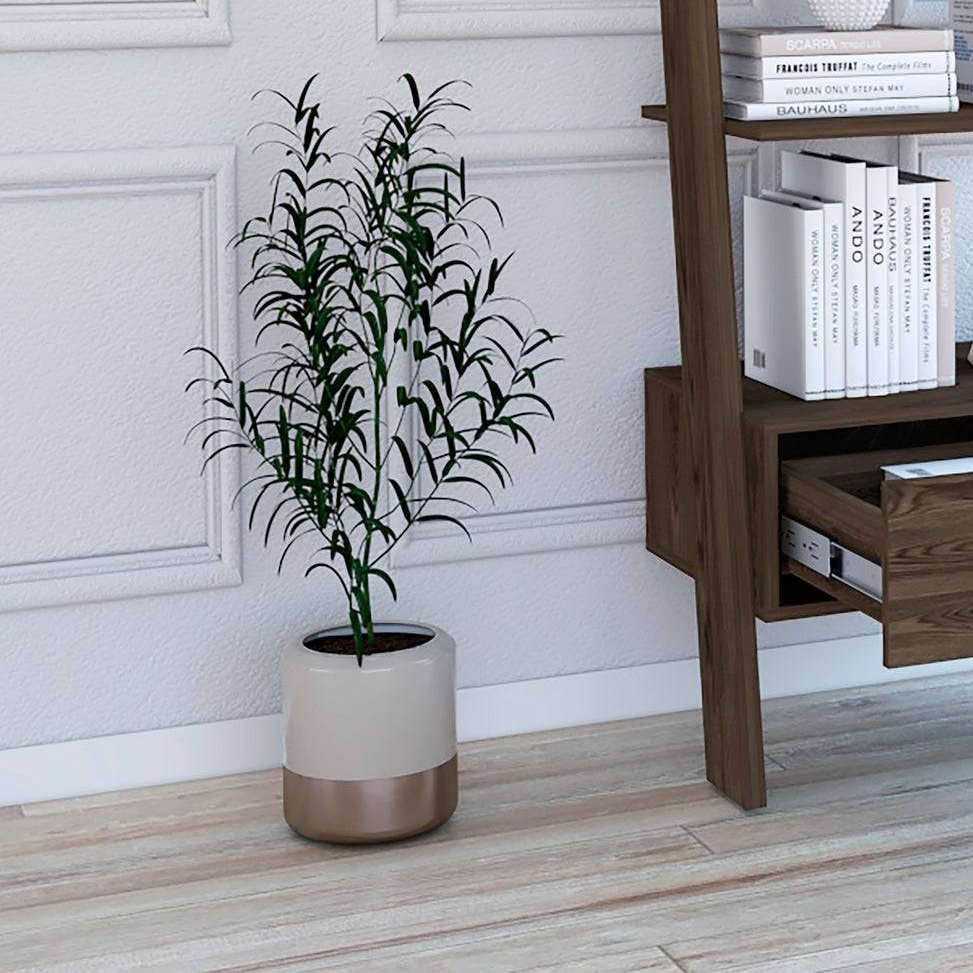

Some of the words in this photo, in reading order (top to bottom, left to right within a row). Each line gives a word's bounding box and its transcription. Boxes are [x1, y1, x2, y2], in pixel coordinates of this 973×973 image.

[785, 38, 837, 51] SCARPA
[776, 63, 818, 73] FRANCOIS
[862, 62, 873, 70] The
[876, 62, 910, 71] Complete
[912, 60, 931, 69] Films
[785, 86, 822, 96] WOMAN
[824, 85, 849, 95] ONLY
[852, 85, 884, 93] STEFAN
[887, 84, 904, 92] MAY
[776, 103, 848, 116] BAUHAUS
[903, 206, 912, 245] WOMAN
[922, 197, 931, 241] FRANCOIS
[940, 206, 951, 260] SCARPA
[811, 230, 819, 266] WOMAN
[852, 206, 863, 263] ANDO
[873, 209, 884, 265] ANDO
[888, 197, 897, 272] BAUHAUS
[903, 249, 912, 275] ONLY
[811, 269, 819, 292] ONLY
[903, 278, 911, 312] STEFAN
[922, 287, 930, 300] The
[903, 316, 911, 333] MAY
[921, 304, 930, 339] Complete
[922, 343, 930, 363] Films
